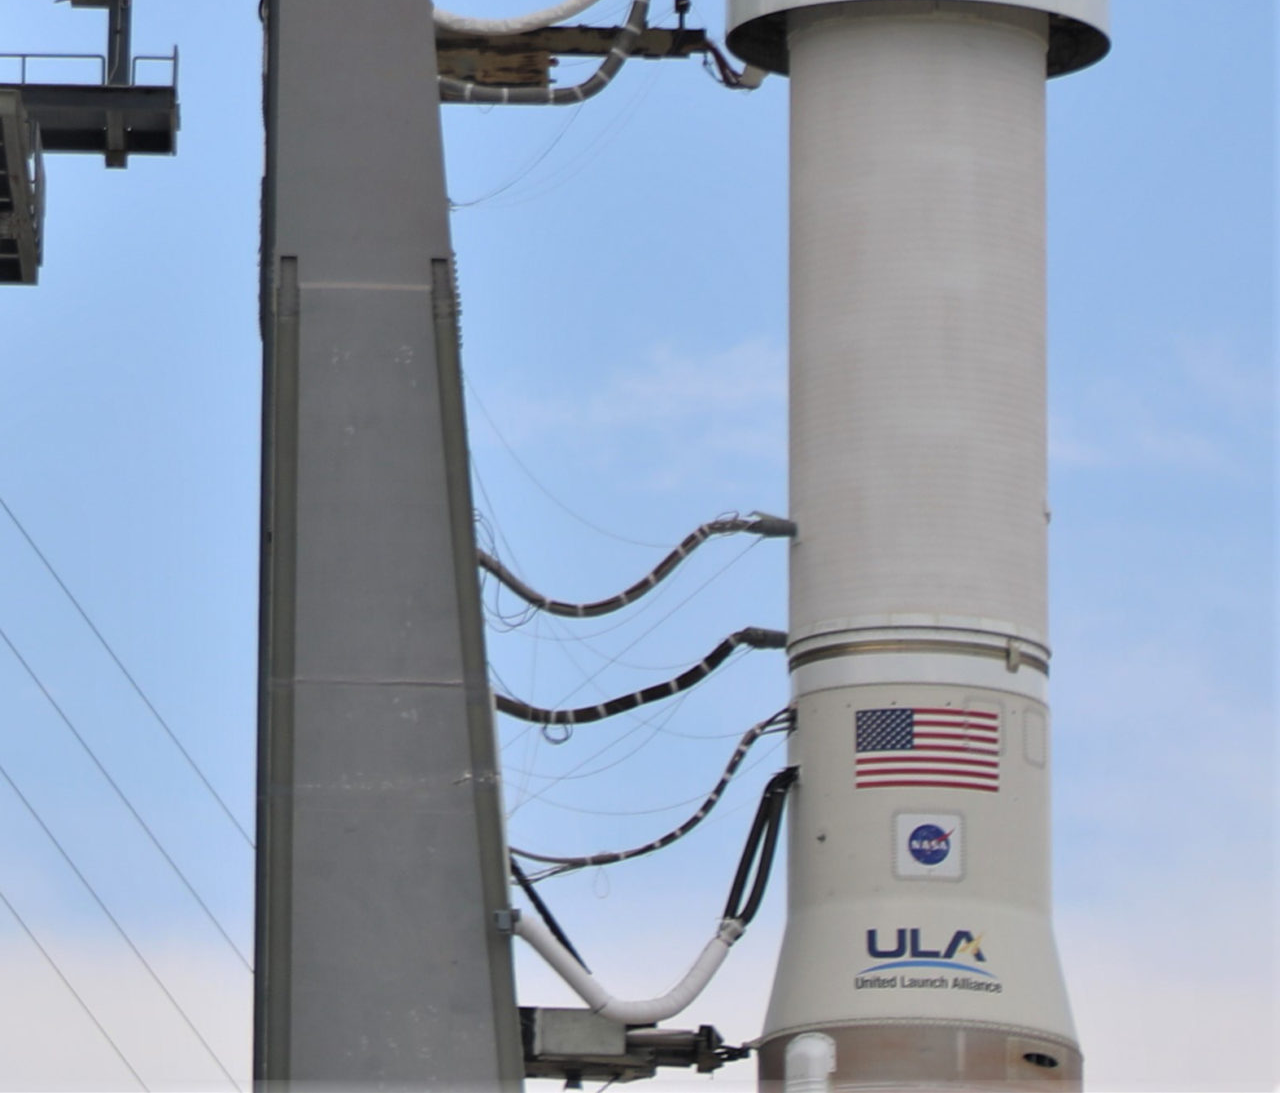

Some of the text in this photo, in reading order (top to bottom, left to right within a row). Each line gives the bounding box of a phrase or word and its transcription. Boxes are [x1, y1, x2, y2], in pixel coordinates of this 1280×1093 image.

[911, 839, 948, 850] NASA
[866, 928, 987, 962] ULA
[854, 976, 1003, 994] United Launch Alliance
